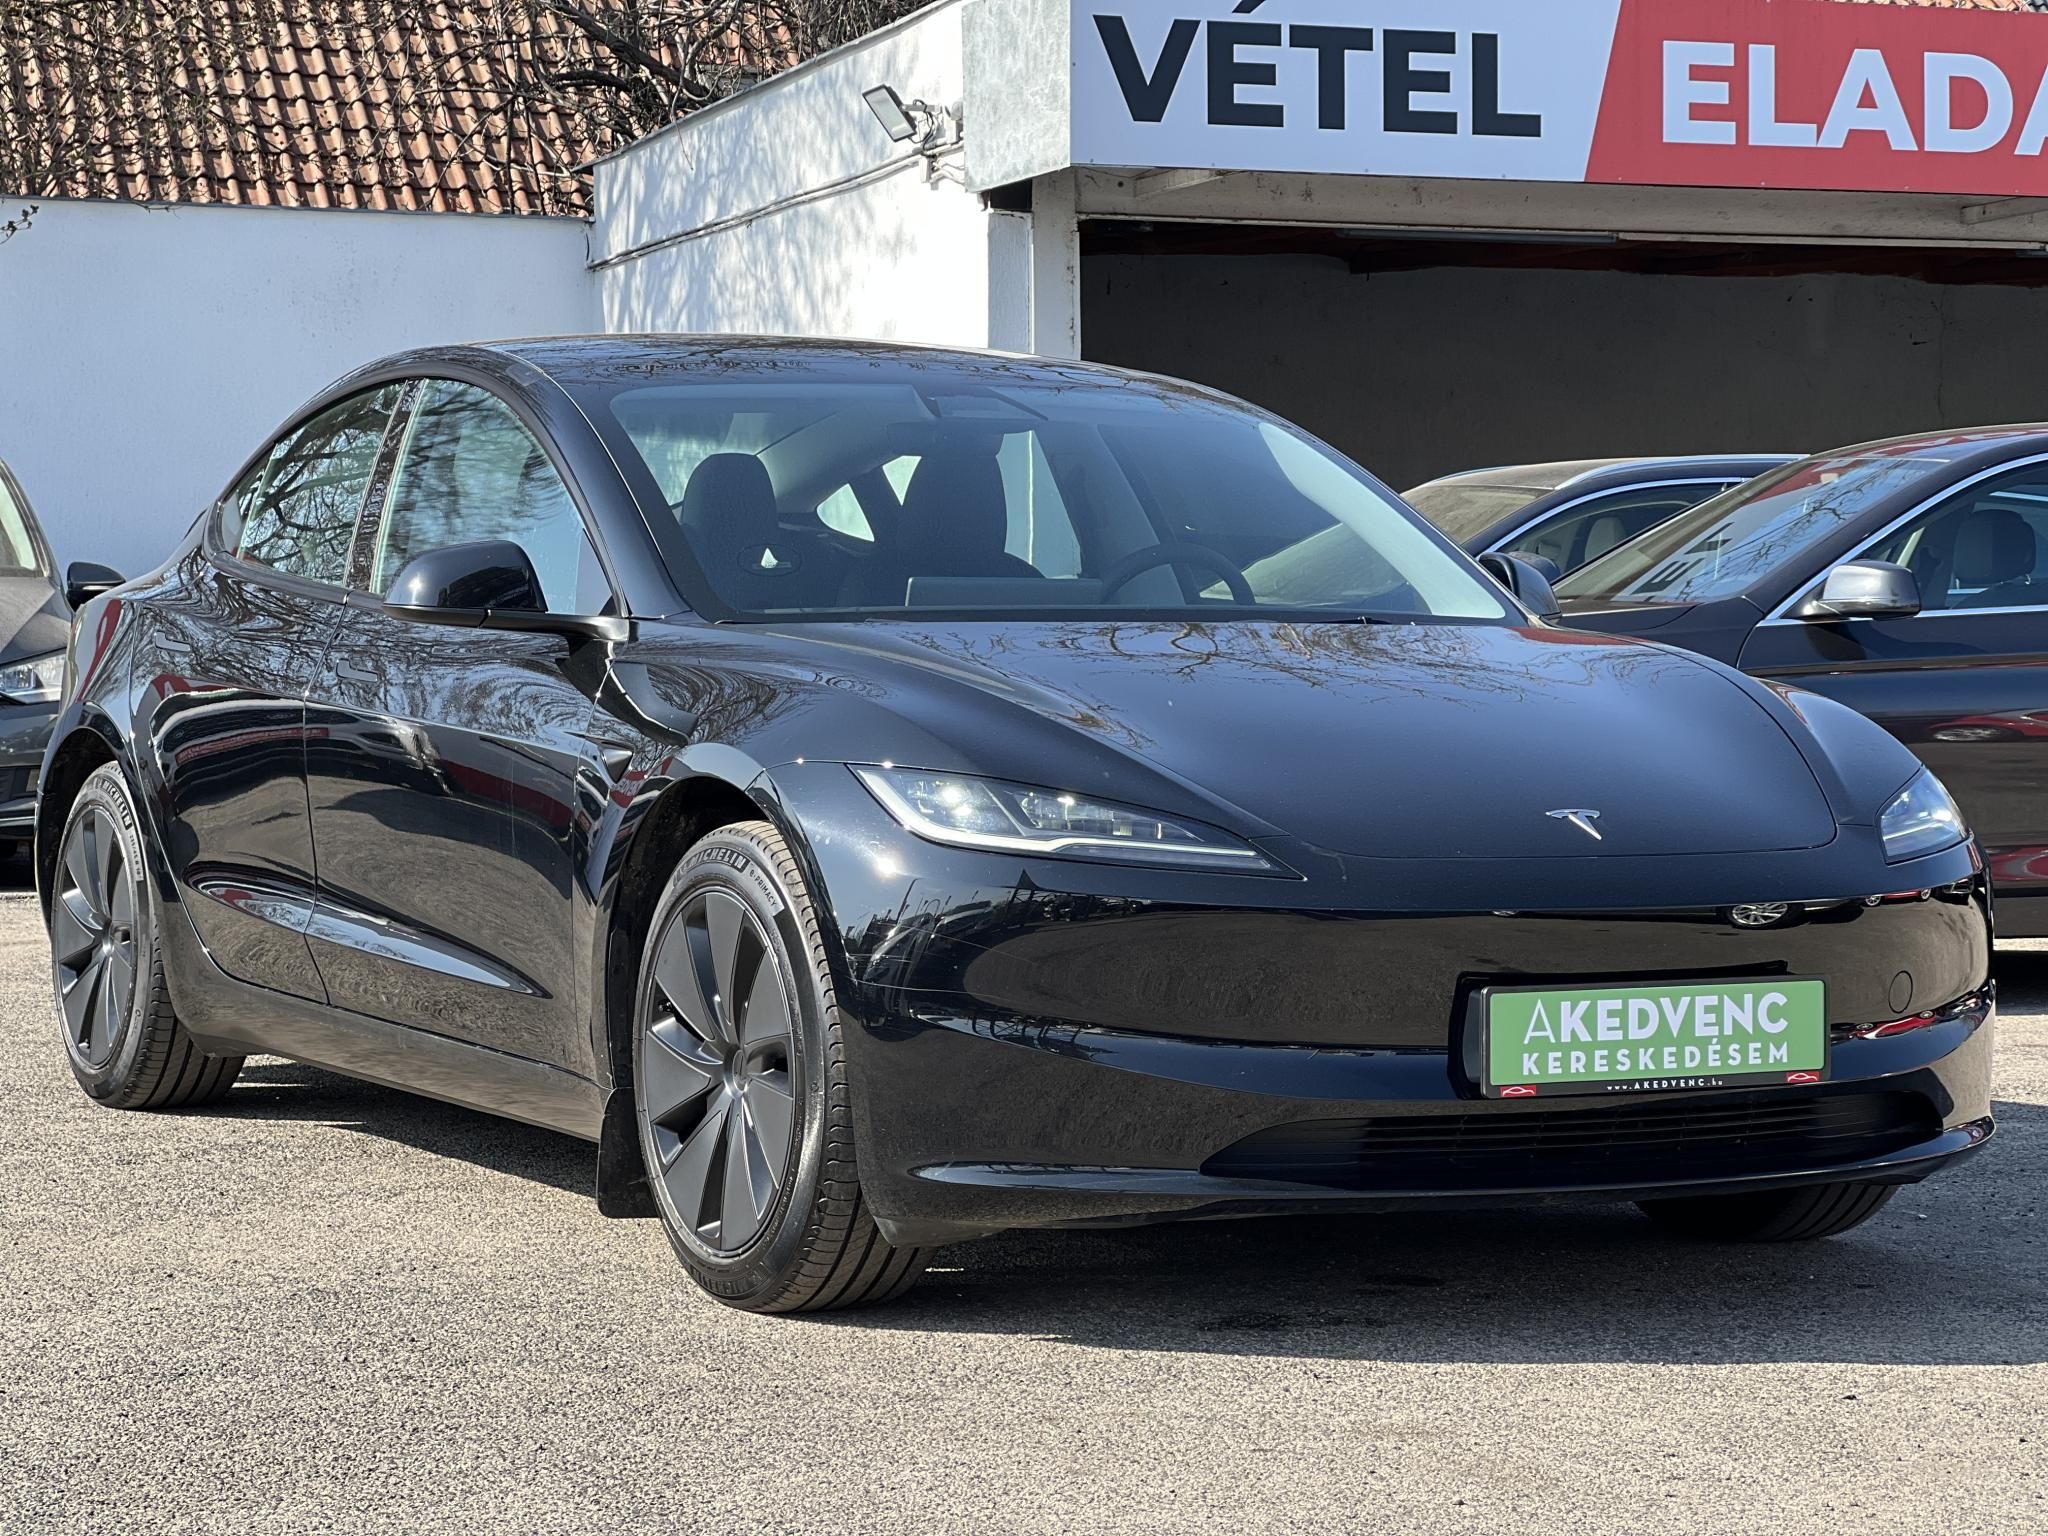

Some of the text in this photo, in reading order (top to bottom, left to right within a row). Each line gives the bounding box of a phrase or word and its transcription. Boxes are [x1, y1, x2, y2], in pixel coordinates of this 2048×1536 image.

[1093, 0, 1542, 138] VÉTEL
[102, 780, 133, 827] MICHELIN
[689, 847, 747, 869] MICHELIN
[1522, 1037, 1789, 1076] KERESKEDÉSEM
[1606, 1078, 1724, 1091] www.AKEDVENC.hu
